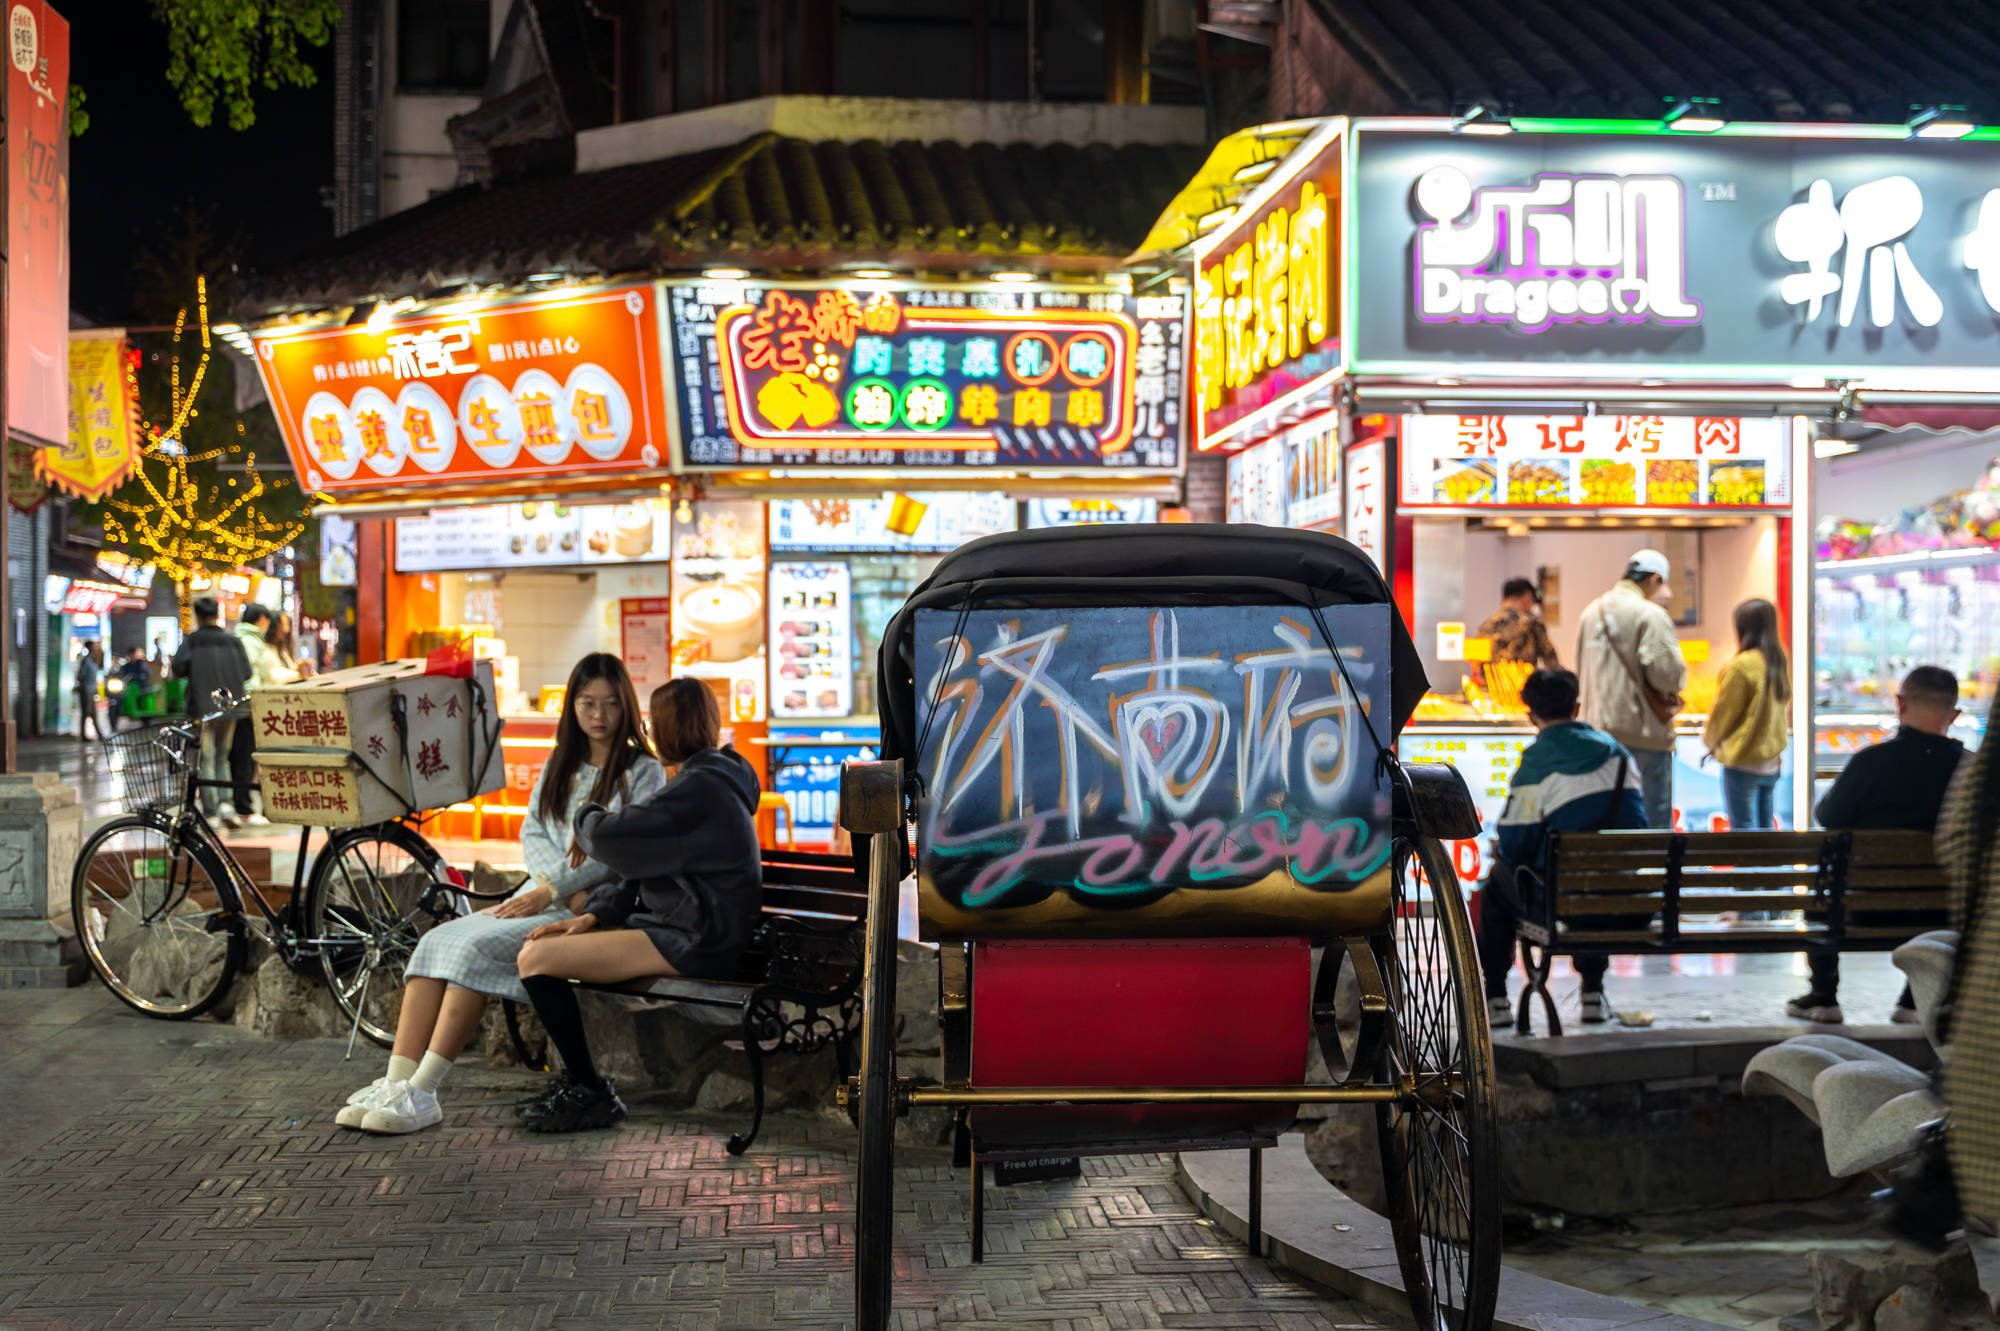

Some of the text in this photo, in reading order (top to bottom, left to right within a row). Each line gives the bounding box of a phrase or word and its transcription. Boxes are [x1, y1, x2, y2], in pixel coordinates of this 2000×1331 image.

[1703, 185, 1737, 201] TM
[467, 388, 616, 448] 生煎包
[262, 709, 347, 737] 文创雪糕
[269, 769, 346, 788] 哈密瓜口味
[272, 792, 349, 813] 杨枝甘露口味
